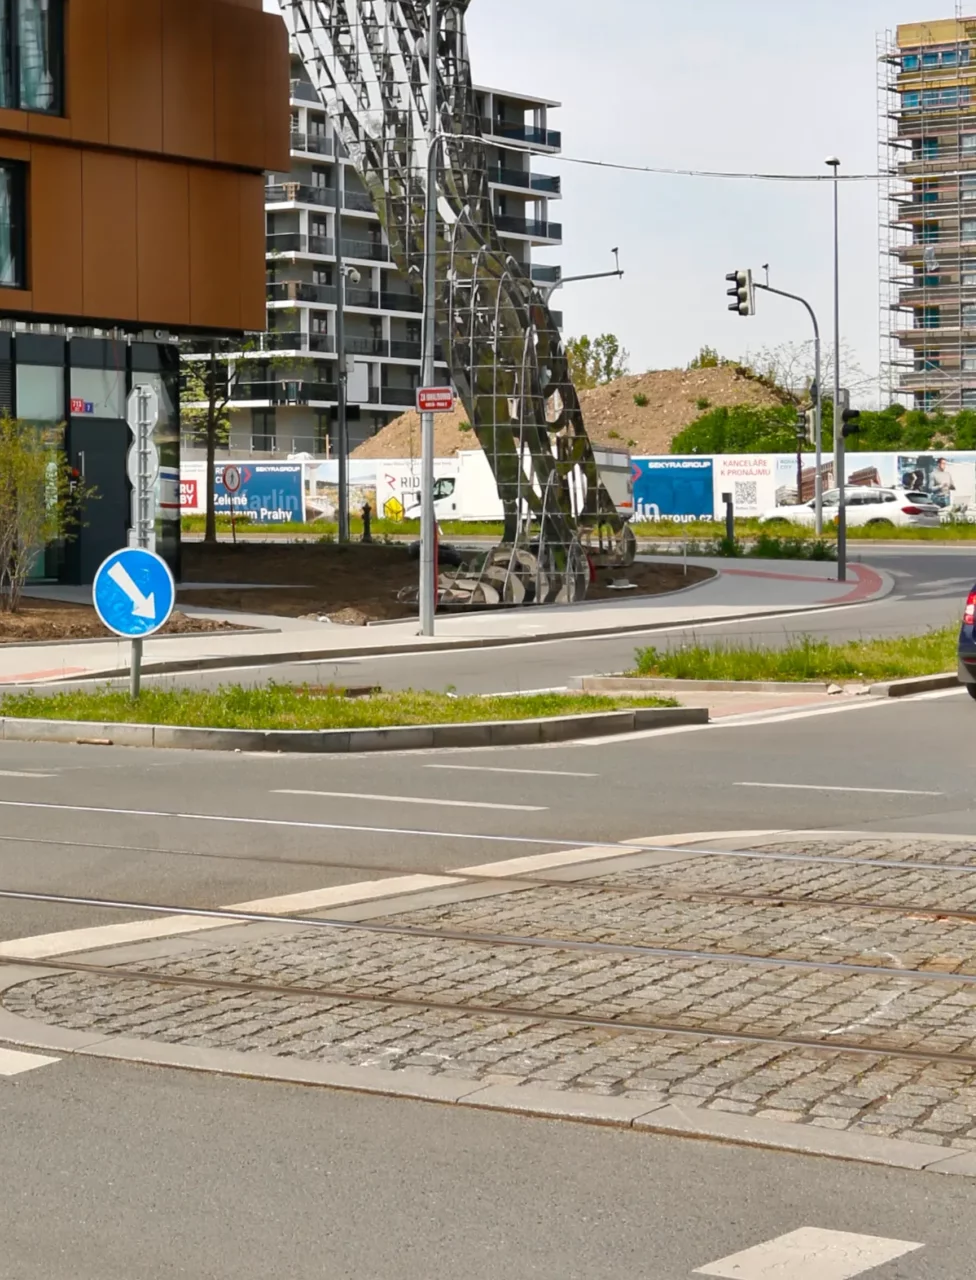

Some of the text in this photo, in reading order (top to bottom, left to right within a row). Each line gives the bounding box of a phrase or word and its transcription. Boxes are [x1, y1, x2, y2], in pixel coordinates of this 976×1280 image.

[722, 459, 768, 467] KANCELÁŘE
[727, 468, 771, 476] PRONÁJMU
[400, 477, 421, 488] RID
[213, 493, 248, 505] Zelené
[260, 507, 293, 522] Prahy
